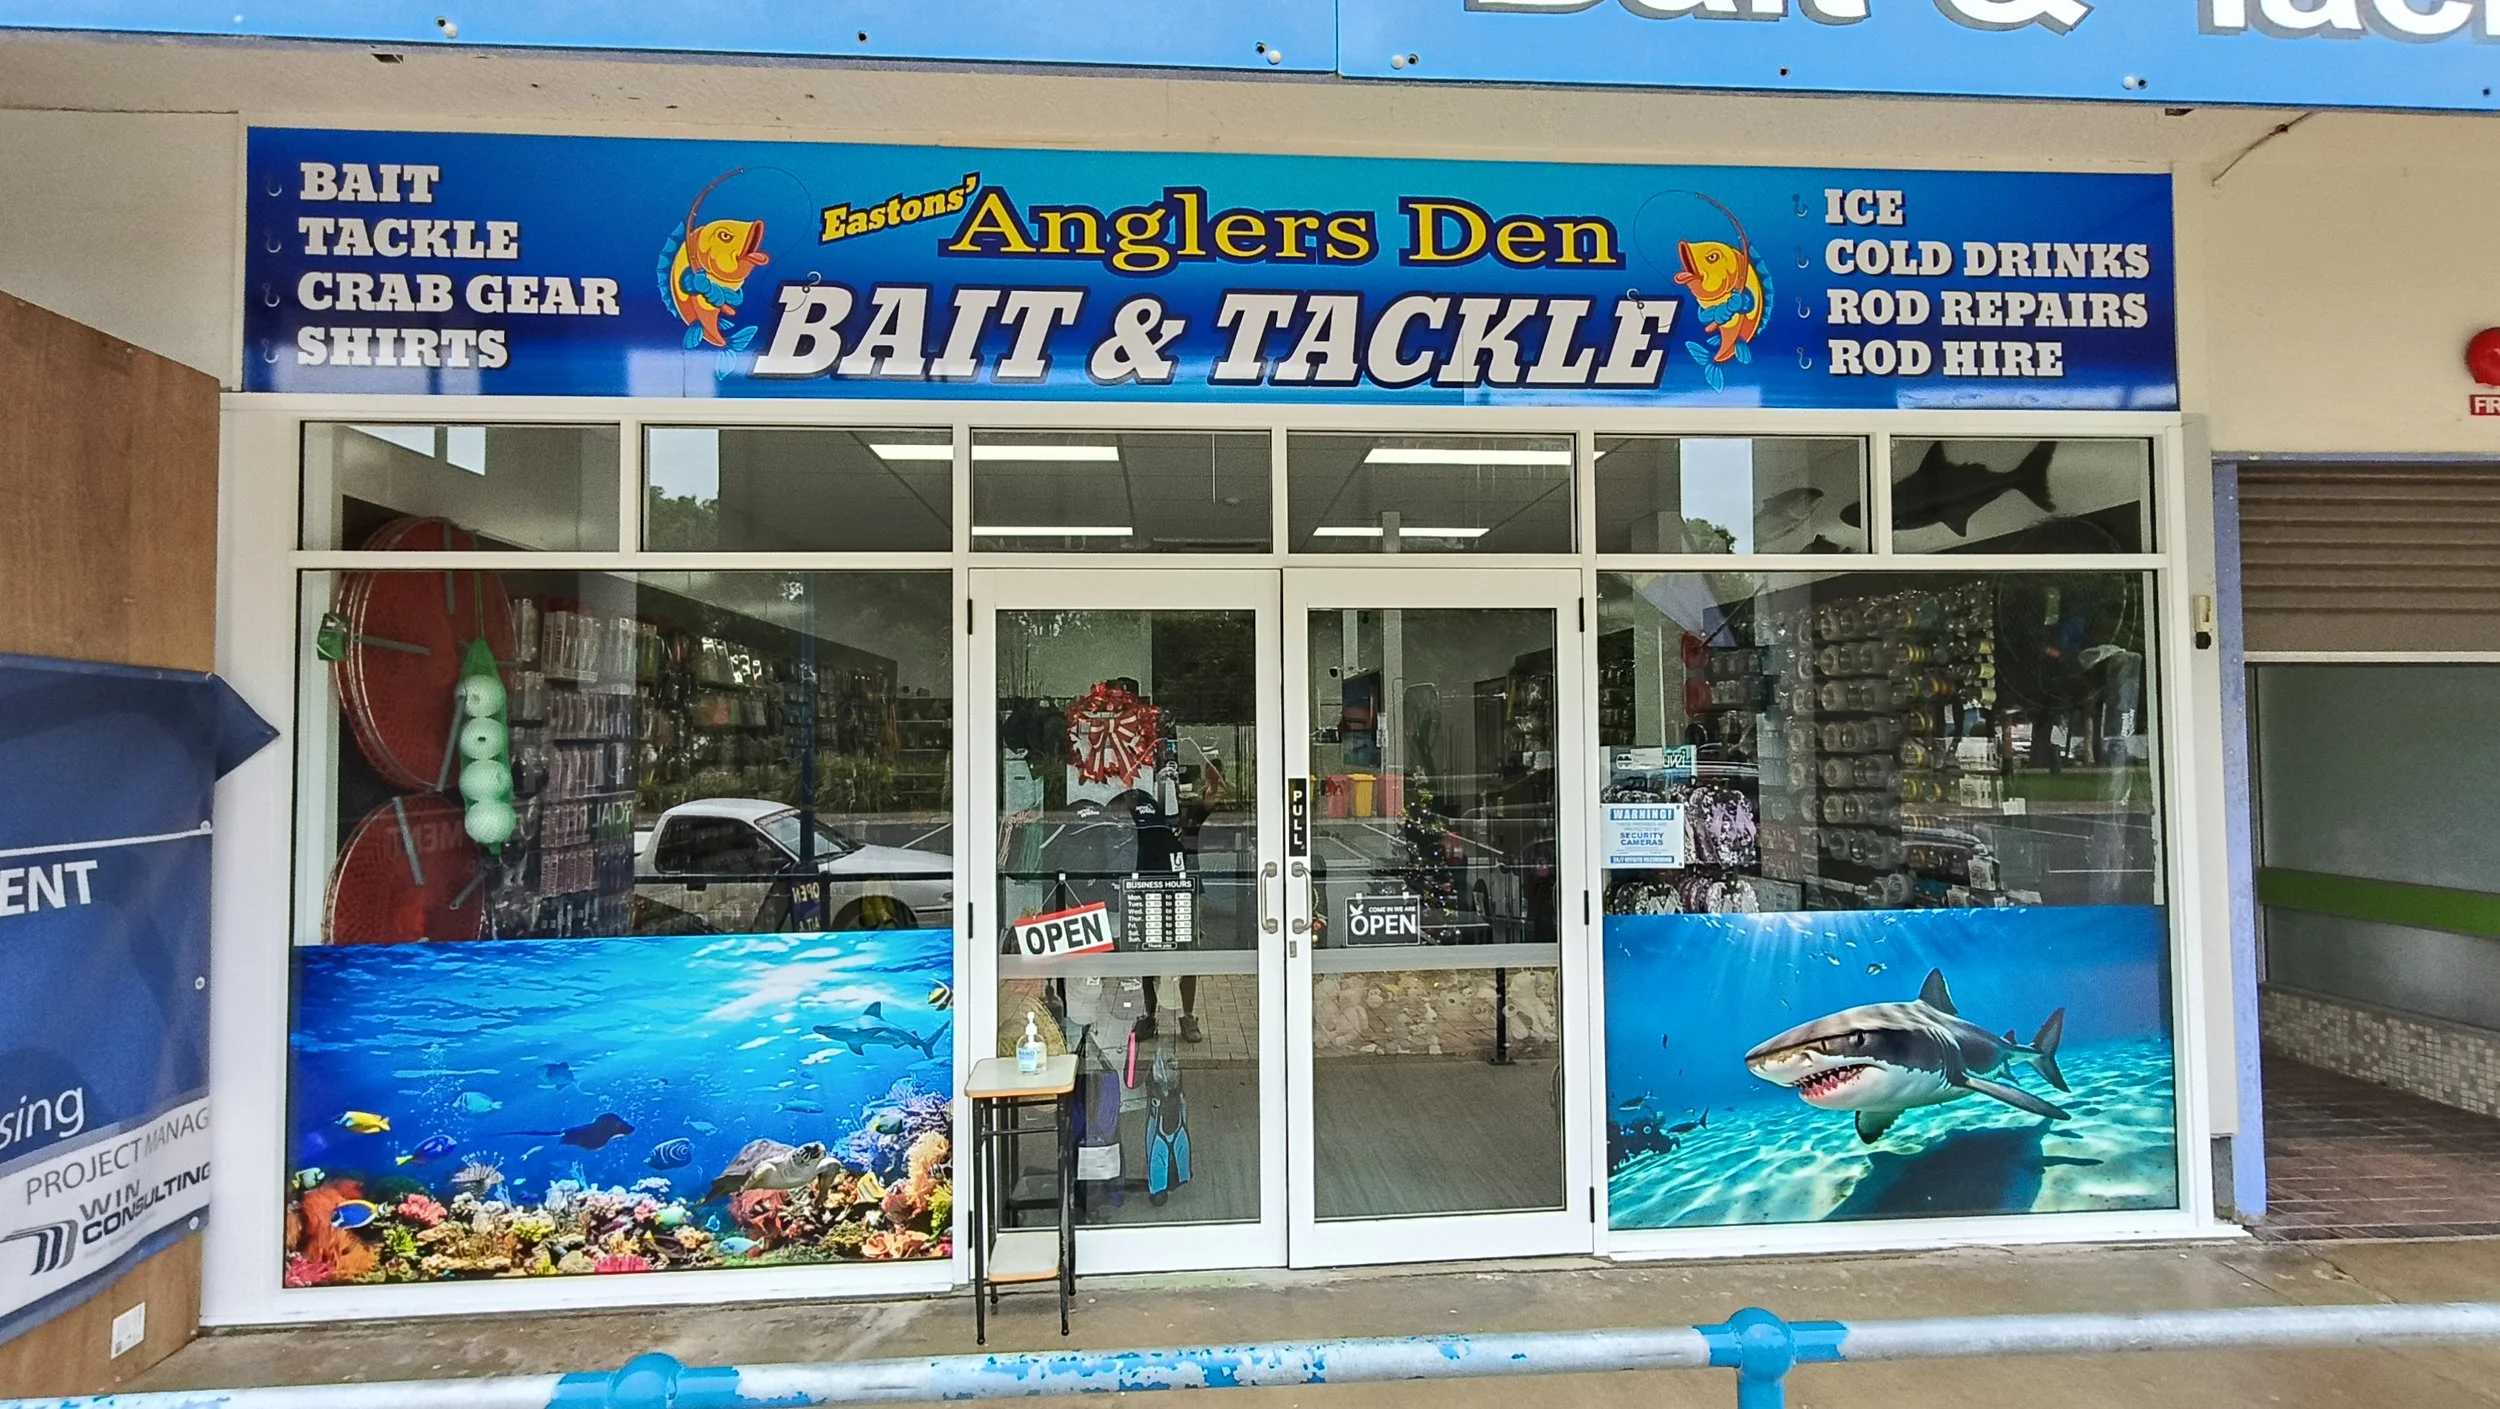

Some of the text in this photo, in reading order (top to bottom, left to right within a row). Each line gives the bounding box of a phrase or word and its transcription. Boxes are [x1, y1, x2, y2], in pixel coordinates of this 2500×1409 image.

[301, 163, 439, 203] BAIT
[1824, 189, 1903, 225] ICE
[299, 217, 518, 259] TACKLE
[948, 194, 1370, 271] Anglers
[1408, 203, 1617, 265] Den
[1825, 239, 2150, 279] COLD DRINKS
[298, 272, 620, 316] CRAB GEAR
[1827, 289, 2148, 328] ROD REPAIRS
[297, 327, 508, 369] SHIRTS
[752, 286, 1679, 384] BAIT & TACKLE
[1828, 339, 2063, 377] ROD HIRE
[1292, 790, 1303, 845] PULL
[1613, 808, 1672, 820] WARNING!
[0, 860, 98, 916] ENT
[1126, 880, 1192, 889] BUSINESS HOURS
[1026, 913, 1104, 955] OPEN
[1350, 914, 1416, 936] OPEN
[26, 1138, 143, 1206] PROJECT
[79, 1179, 141, 1221] WIN
[82, 1162, 210, 1245] CONSULTING
